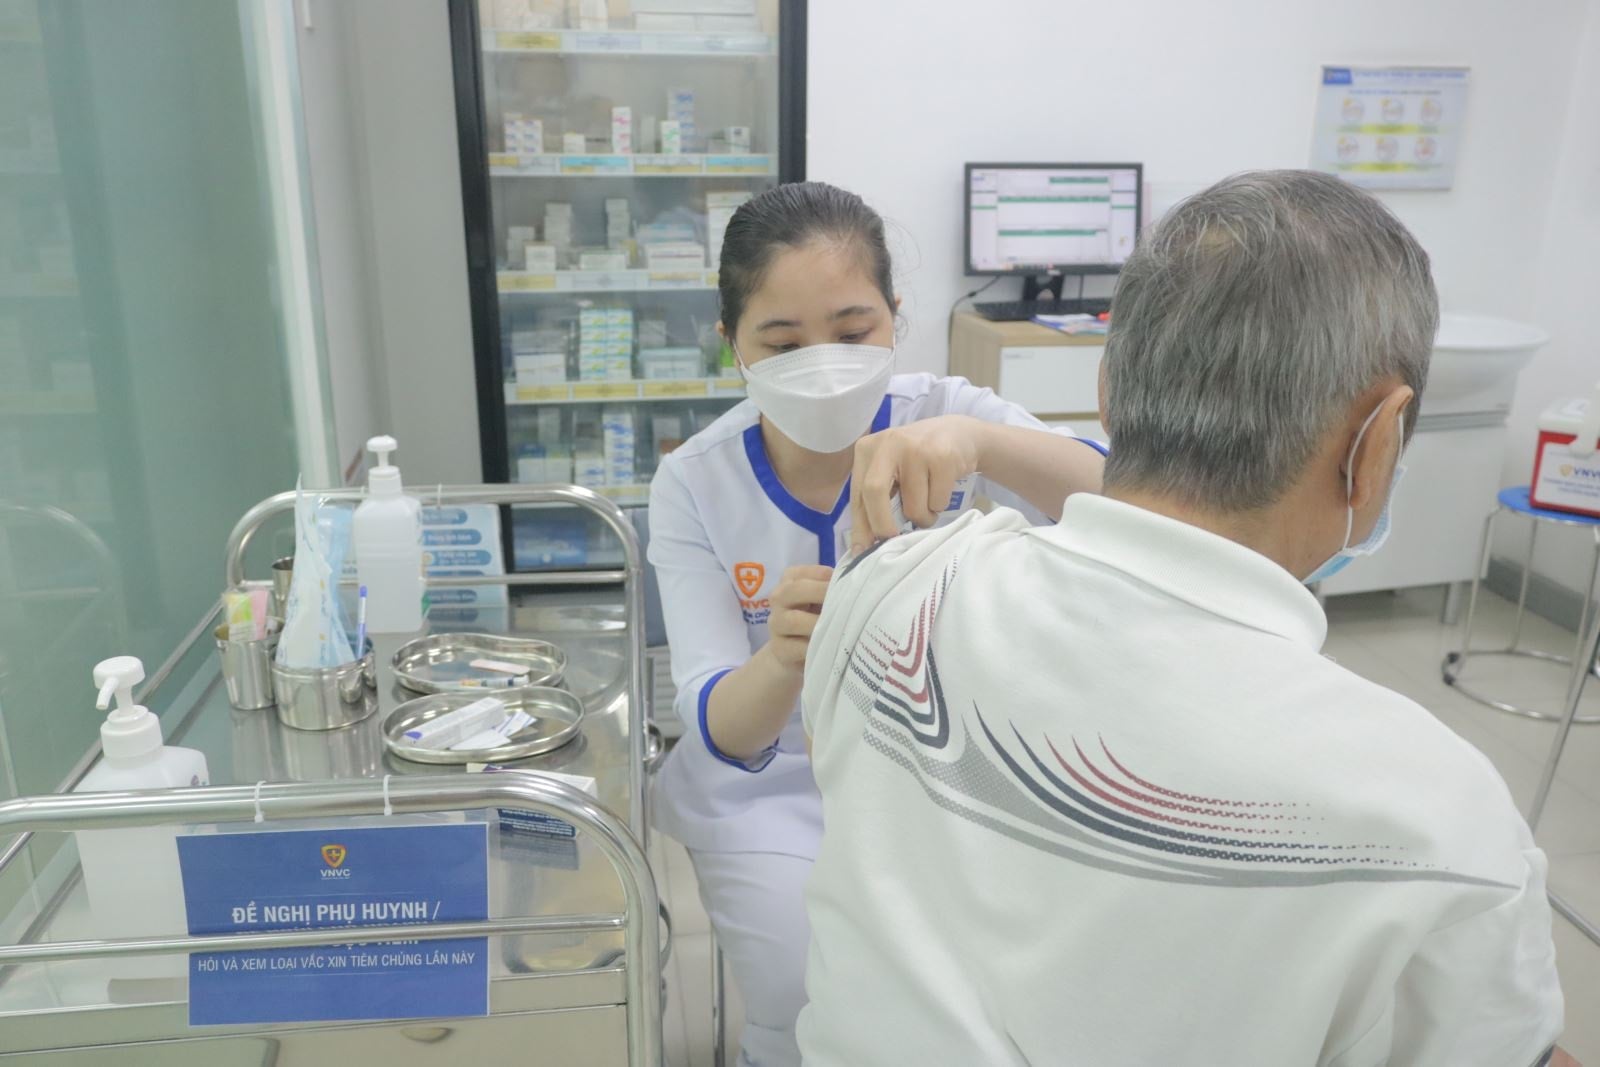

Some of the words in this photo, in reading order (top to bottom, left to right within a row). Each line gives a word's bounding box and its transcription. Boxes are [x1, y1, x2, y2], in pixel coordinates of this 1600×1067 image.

[320, 868, 351, 877] VNVC
[232, 901, 258, 924] ĐỀ
[264, 905, 310, 925] NGHỊ
[316, 903, 355, 924] PHỤ
[362, 901, 427, 920] HUYNH
[222, 956, 239, 971] VÀ
[241, 957, 267, 970] XEM
[270, 957, 297, 971] LOẠI
[327, 955, 347, 968] XIN
[350, 952, 378, 967] TIÊM
[425, 950, 448, 965] LẦN
[451, 950, 475, 965] NÀY
